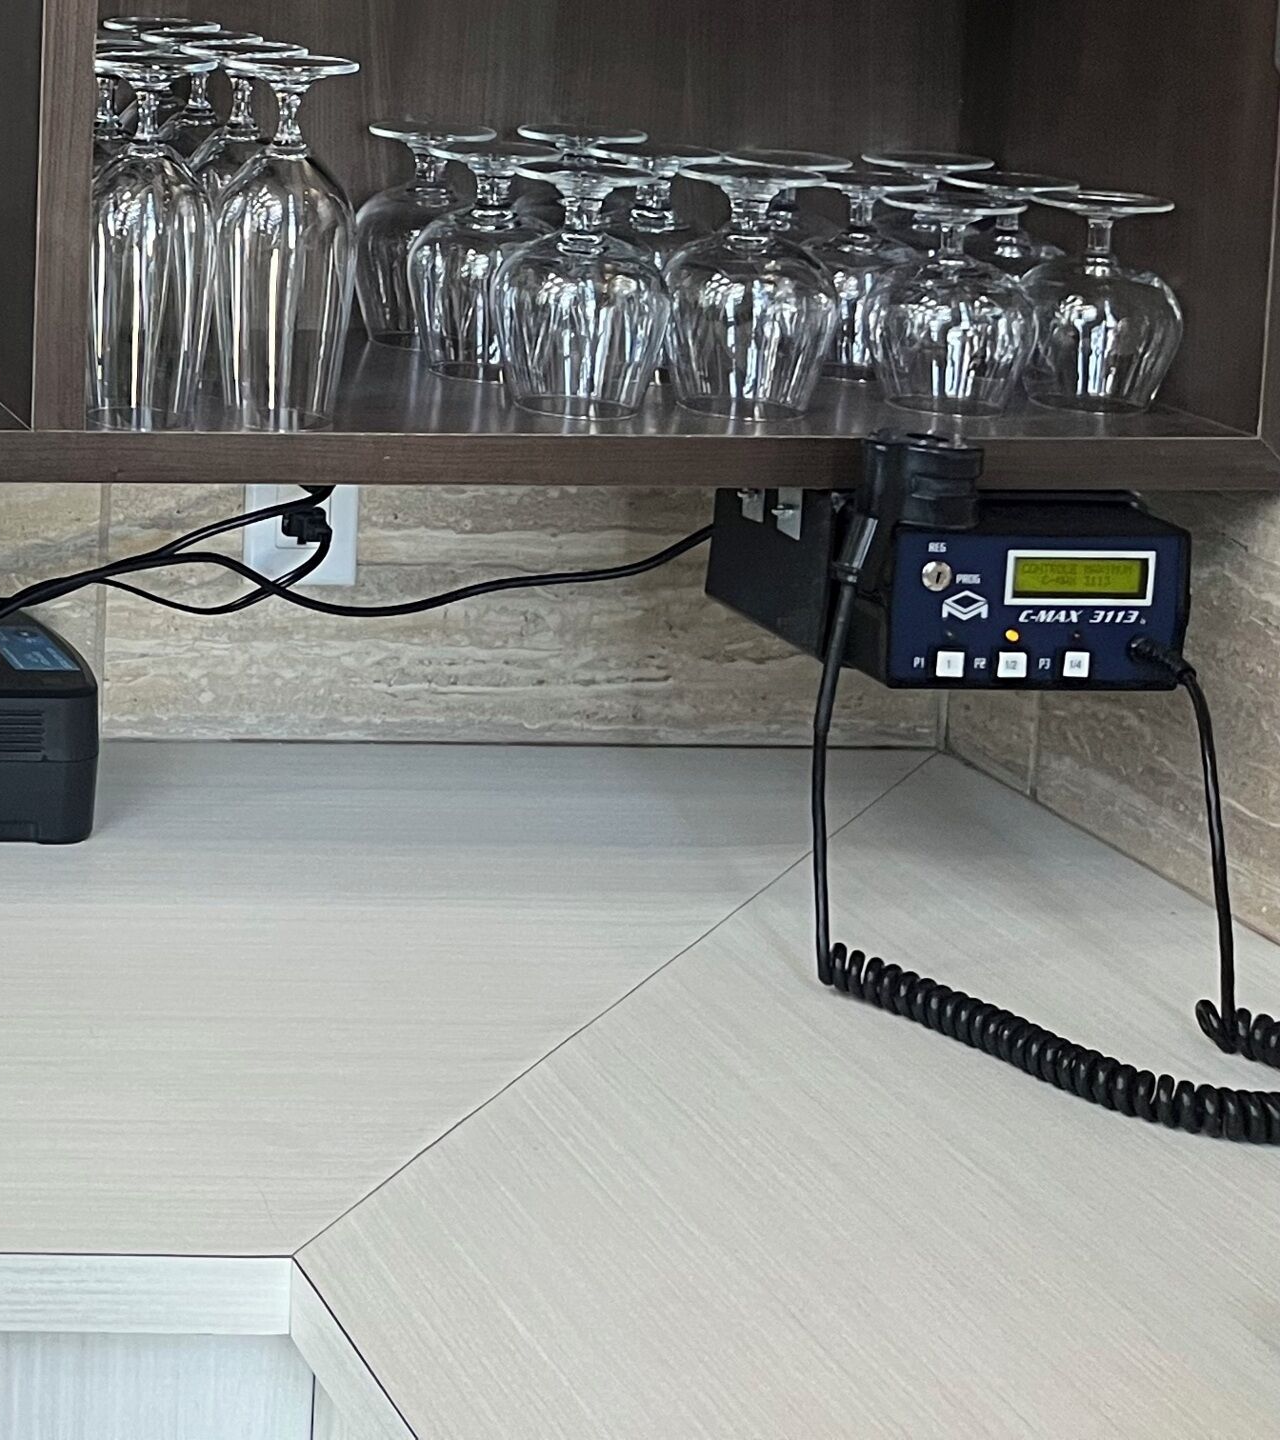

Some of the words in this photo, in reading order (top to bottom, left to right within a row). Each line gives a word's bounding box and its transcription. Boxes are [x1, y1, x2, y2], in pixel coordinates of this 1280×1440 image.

[1018, 610, 1083, 623] C-MAX
[1088, 610, 1139, 623] 3113
[913, 656, 925, 669] P1
[1038, 657, 1051, 670] P3
